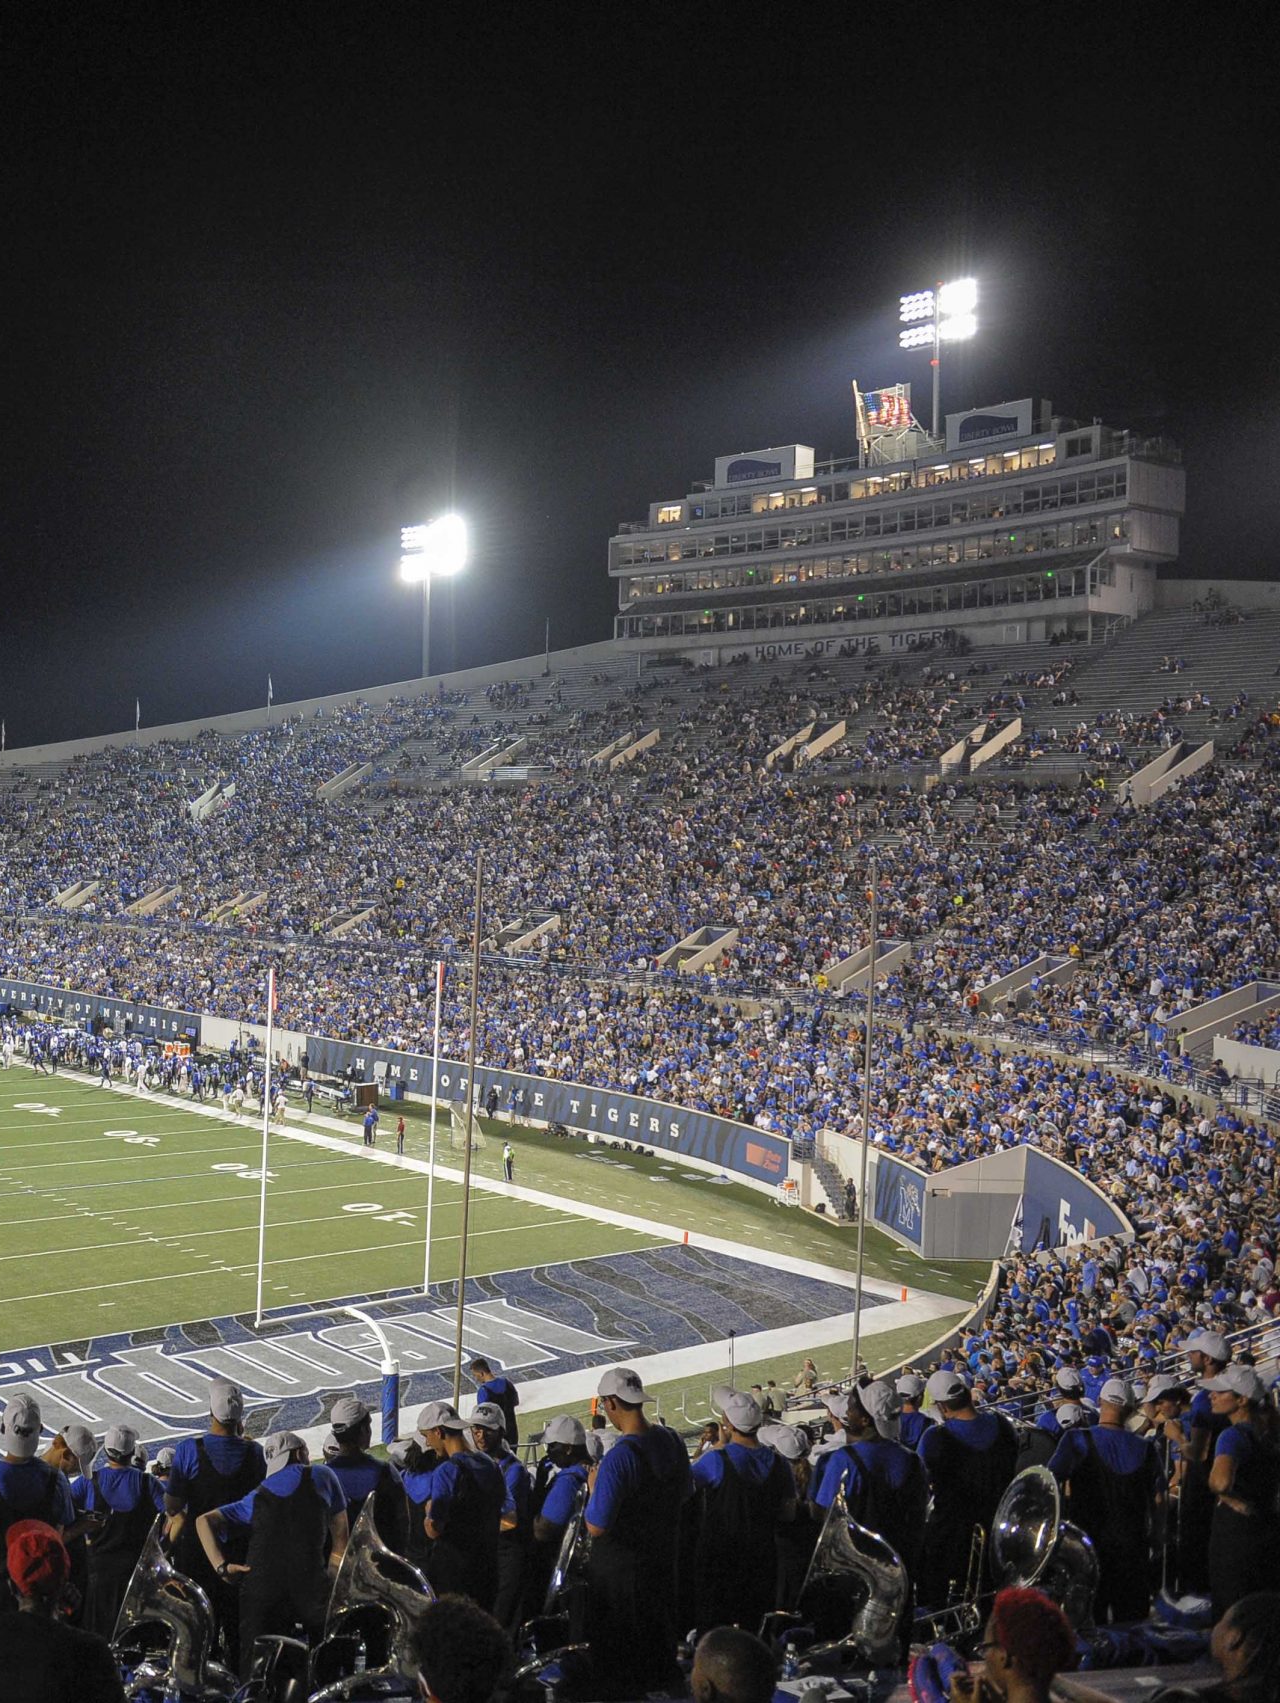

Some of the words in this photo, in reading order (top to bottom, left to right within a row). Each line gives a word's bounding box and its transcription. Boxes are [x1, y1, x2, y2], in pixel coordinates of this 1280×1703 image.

[755, 642, 805, 659] HOME
[814, 639, 836, 653] OF
[845, 635, 879, 650] THE
[888, 631, 945, 648] TIGER
[75, 1002, 91, 1014] OF
[103, 1007, 178, 1032] MEMPHIS
[355, 1057, 419, 1081] HME
[440, 1074, 469, 1091] OF
[570, 1100, 680, 1138] TIGERS
[341, 1203, 419, 1222] 10
